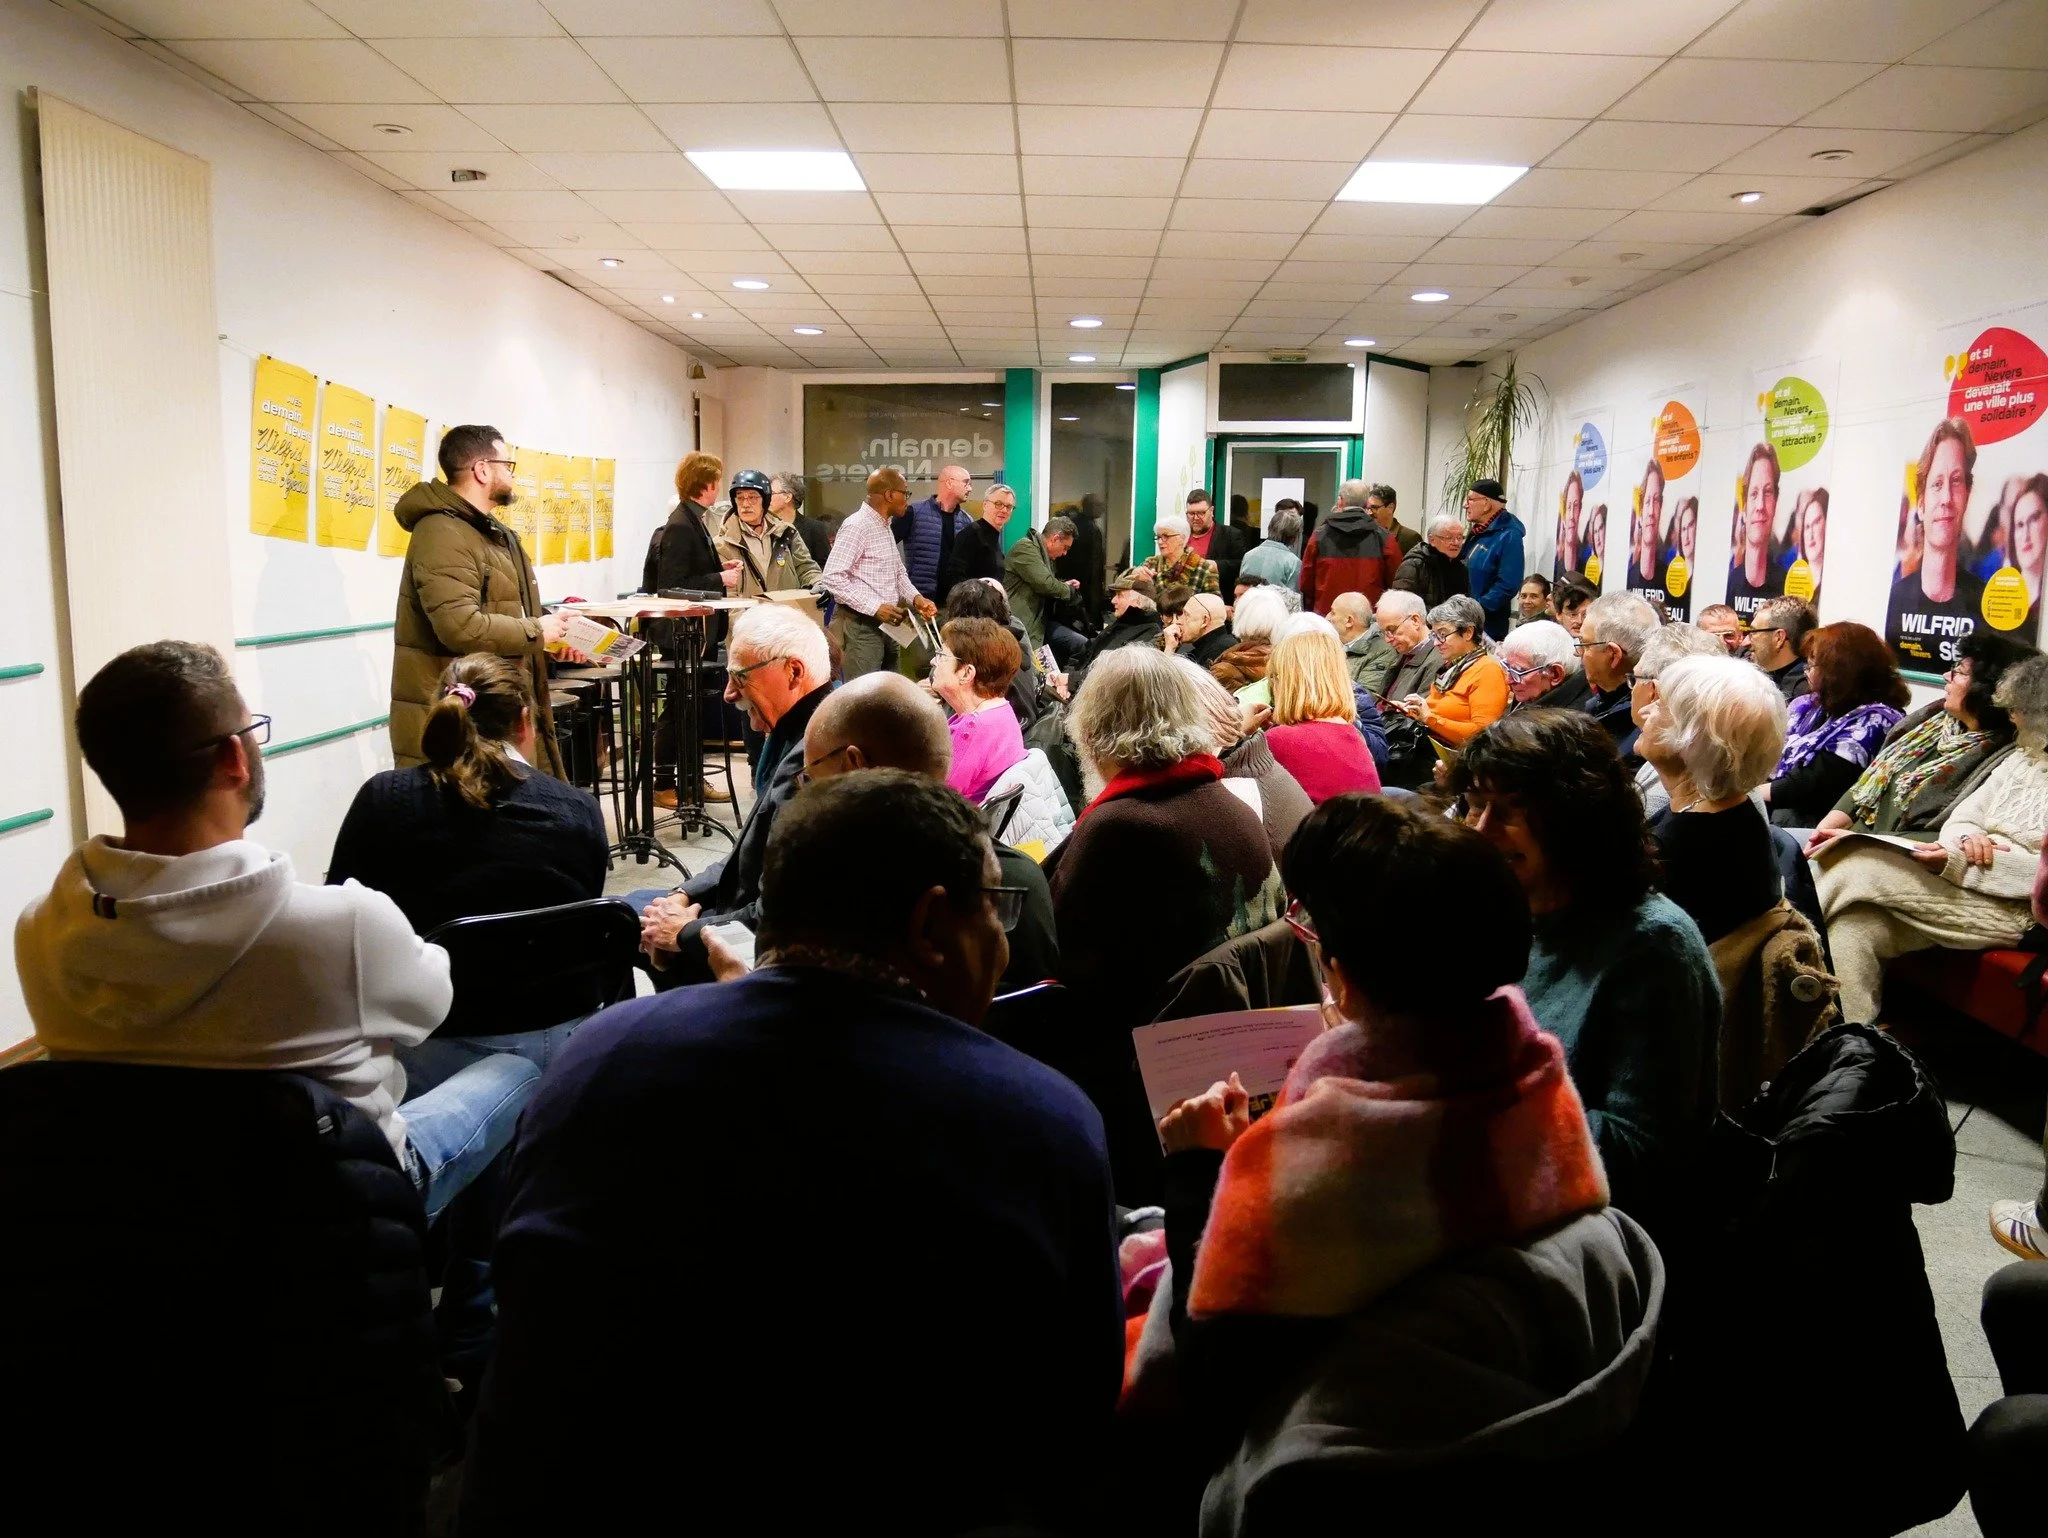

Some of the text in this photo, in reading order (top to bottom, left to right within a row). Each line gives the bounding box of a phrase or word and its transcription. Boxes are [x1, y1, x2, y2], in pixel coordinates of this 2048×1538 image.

[1969, 345, 1993, 361] et si
[1984, 367, 2023, 382] Nevers
[1965, 381, 2011, 399] devenait
[1964, 392, 2035, 412] une ville plus
[1980, 406, 2027, 423] solidaire
[284, 421, 312, 443] Nevers
[1781, 434, 1816, 447] attractive
[348, 442, 374, 461] Nevers
[1734, 596, 1767, 613] WILF
[1665, 606, 1684, 621] EAU
[1901, 613, 1974, 637] WILFRID
